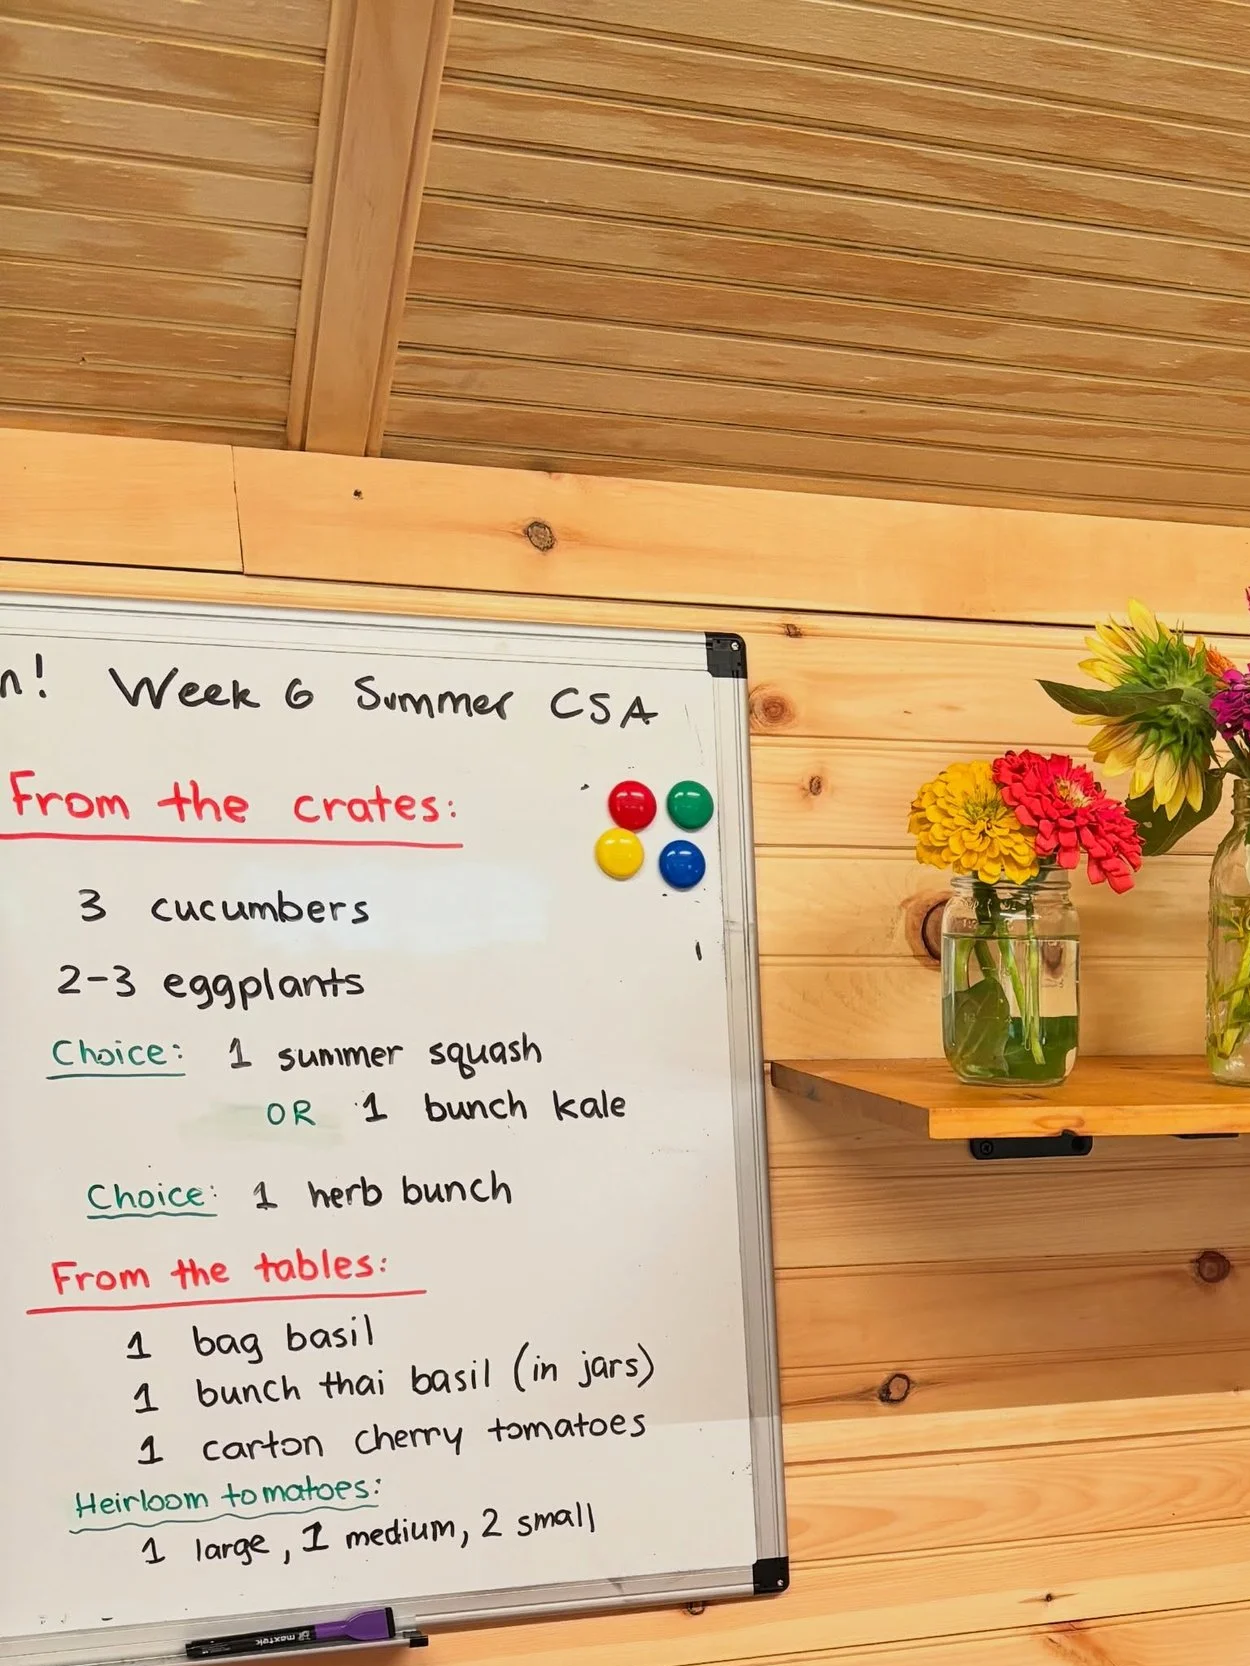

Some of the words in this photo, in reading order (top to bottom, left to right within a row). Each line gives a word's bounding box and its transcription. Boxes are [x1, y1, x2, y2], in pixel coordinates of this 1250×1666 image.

[107, 666, 261, 710] Week
[284, 677, 315, 710] 6
[354, 675, 515, 721] Summer
[550, 686, 659, 729] CSA
[9, 769, 130, 820] From
[156, 779, 250, 824] the
[293, 784, 457, 824] crates:
[78, 888, 107, 923] 3
[150, 889, 370, 925] cucumbers
[57, 964, 136, 998] 2-3
[163, 966, 365, 1012] eggplants
[52, 1038, 183, 1067] Choice:
[228, 1037, 253, 1070] 1
[277, 1044, 404, 1072] summer
[428, 1031, 543, 1080] squash
[266, 1099, 316, 1126] OR
[362, 1091, 388, 1123] 1
[424, 1090, 528, 1123] bunch
[552, 1088, 626, 1122] kale
[87, 1182, 219, 1209] Choice:
[253, 1180, 279, 1211] 1
[307, 1177, 383, 1209] herb
[401, 1169, 512, 1206] bunch
[51, 1261, 151, 1296] From
[170, 1258, 230, 1290] the
[253, 1247, 387, 1283] tables:
[126, 1330, 152, 1360] 1
[191, 1325, 264, 1365] bag
[286, 1313, 374, 1352] basil
[133, 1382, 160, 1414] 1
[195, 1375, 301, 1408] bunch
[318, 1369, 385, 1400] thai
[411, 1358, 490, 1396] basil
[513, 1341, 558, 1393] (in
[577, 1342, 655, 1389] jars)
[137, 1434, 164, 1465] 1
[202, 1433, 324, 1462] carton
[354, 1423, 463, 1456] cherry
[487, 1412, 646, 1443] tomatoes
[75, 1488, 209, 1519] Heirloom
[220, 1475, 382, 1510] tomatoes:
[141, 1536, 166, 1565] 1
[195, 1534, 291, 1567] large,
[301, 1520, 330, 1553] 1
[345, 1518, 469, 1550] medium,
[481, 1507, 503, 1538] 2
[517, 1501, 596, 1537] small
